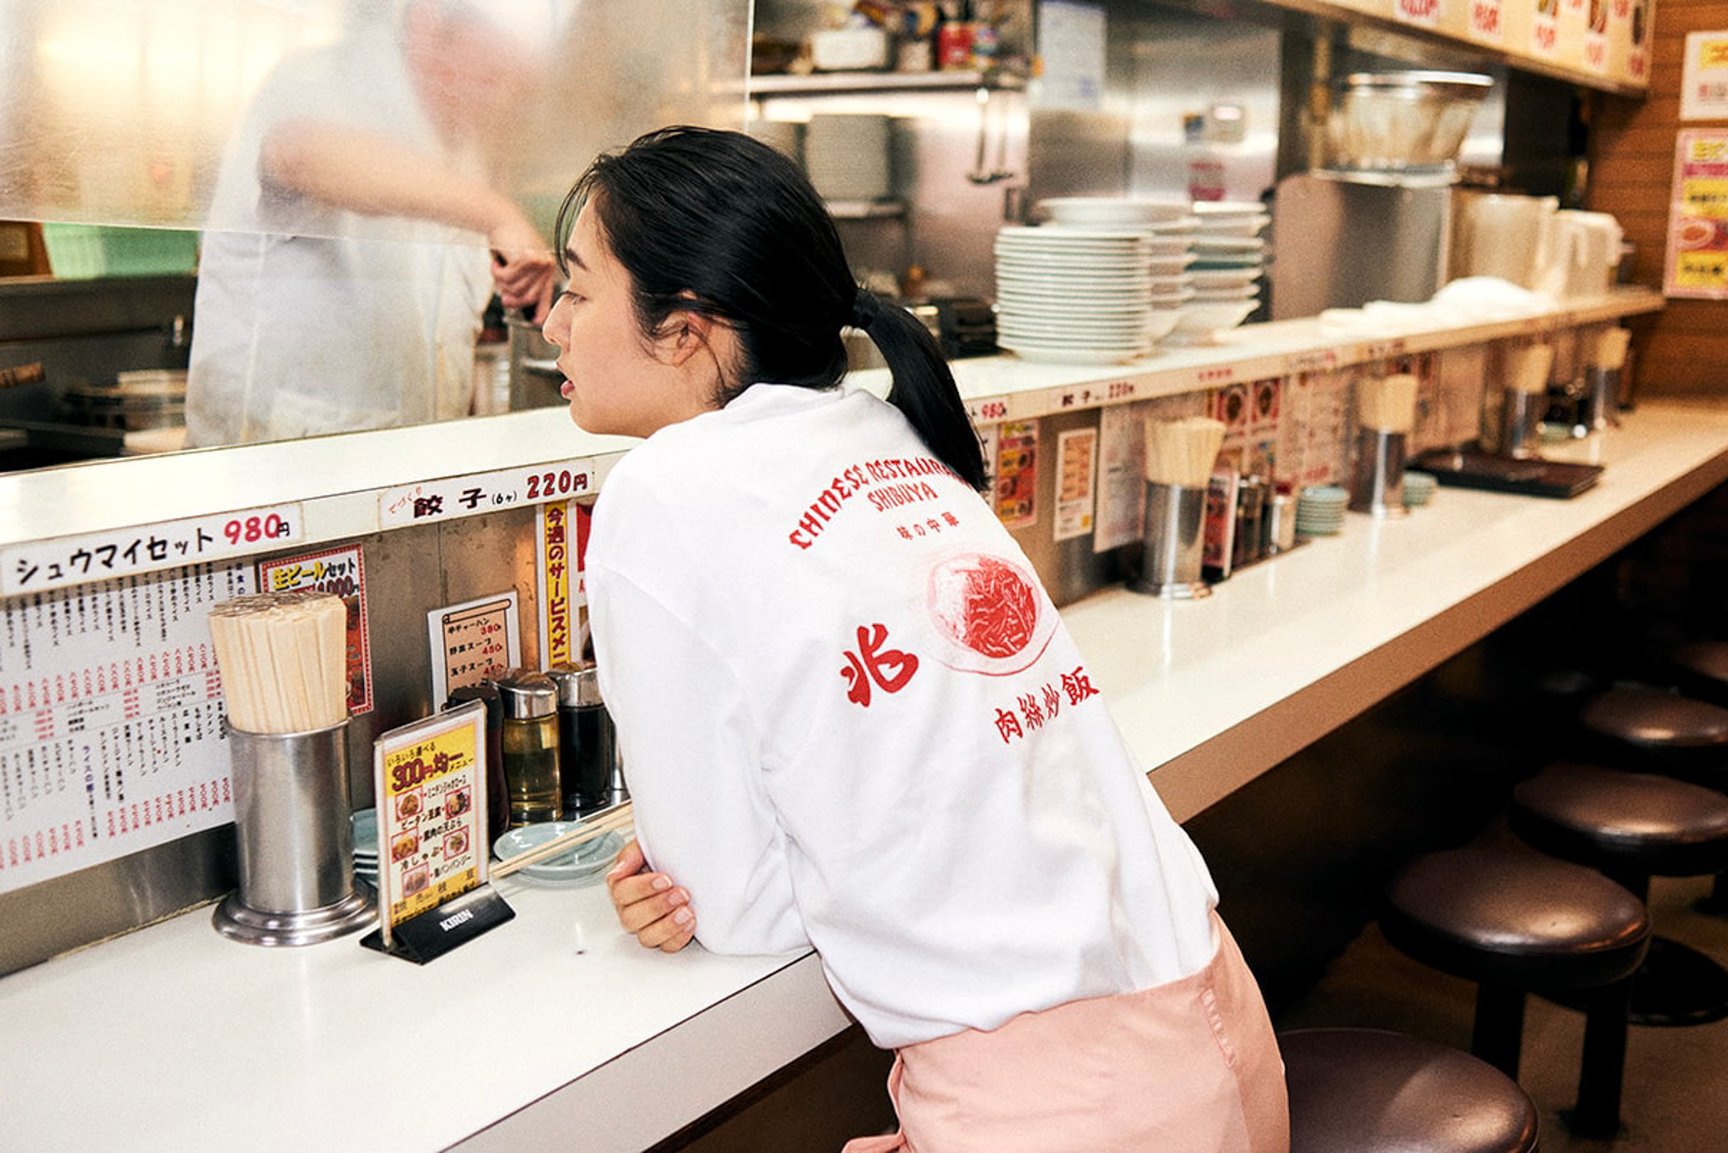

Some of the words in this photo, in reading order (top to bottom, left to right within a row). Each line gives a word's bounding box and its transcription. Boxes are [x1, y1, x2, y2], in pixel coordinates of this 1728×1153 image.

[413, 488, 487, 518] 餃子
[527, 470, 588, 499] 220円
[789, 464, 869, 550] CHINESE
[867, 481, 938, 512] SHIBUYA
[16, 527, 213, 584] シュウマイセット
[224, 513, 290, 545] 980円
[273, 557, 355, 591] 生ビールセット
[439, 909, 474, 932] KIRIN
